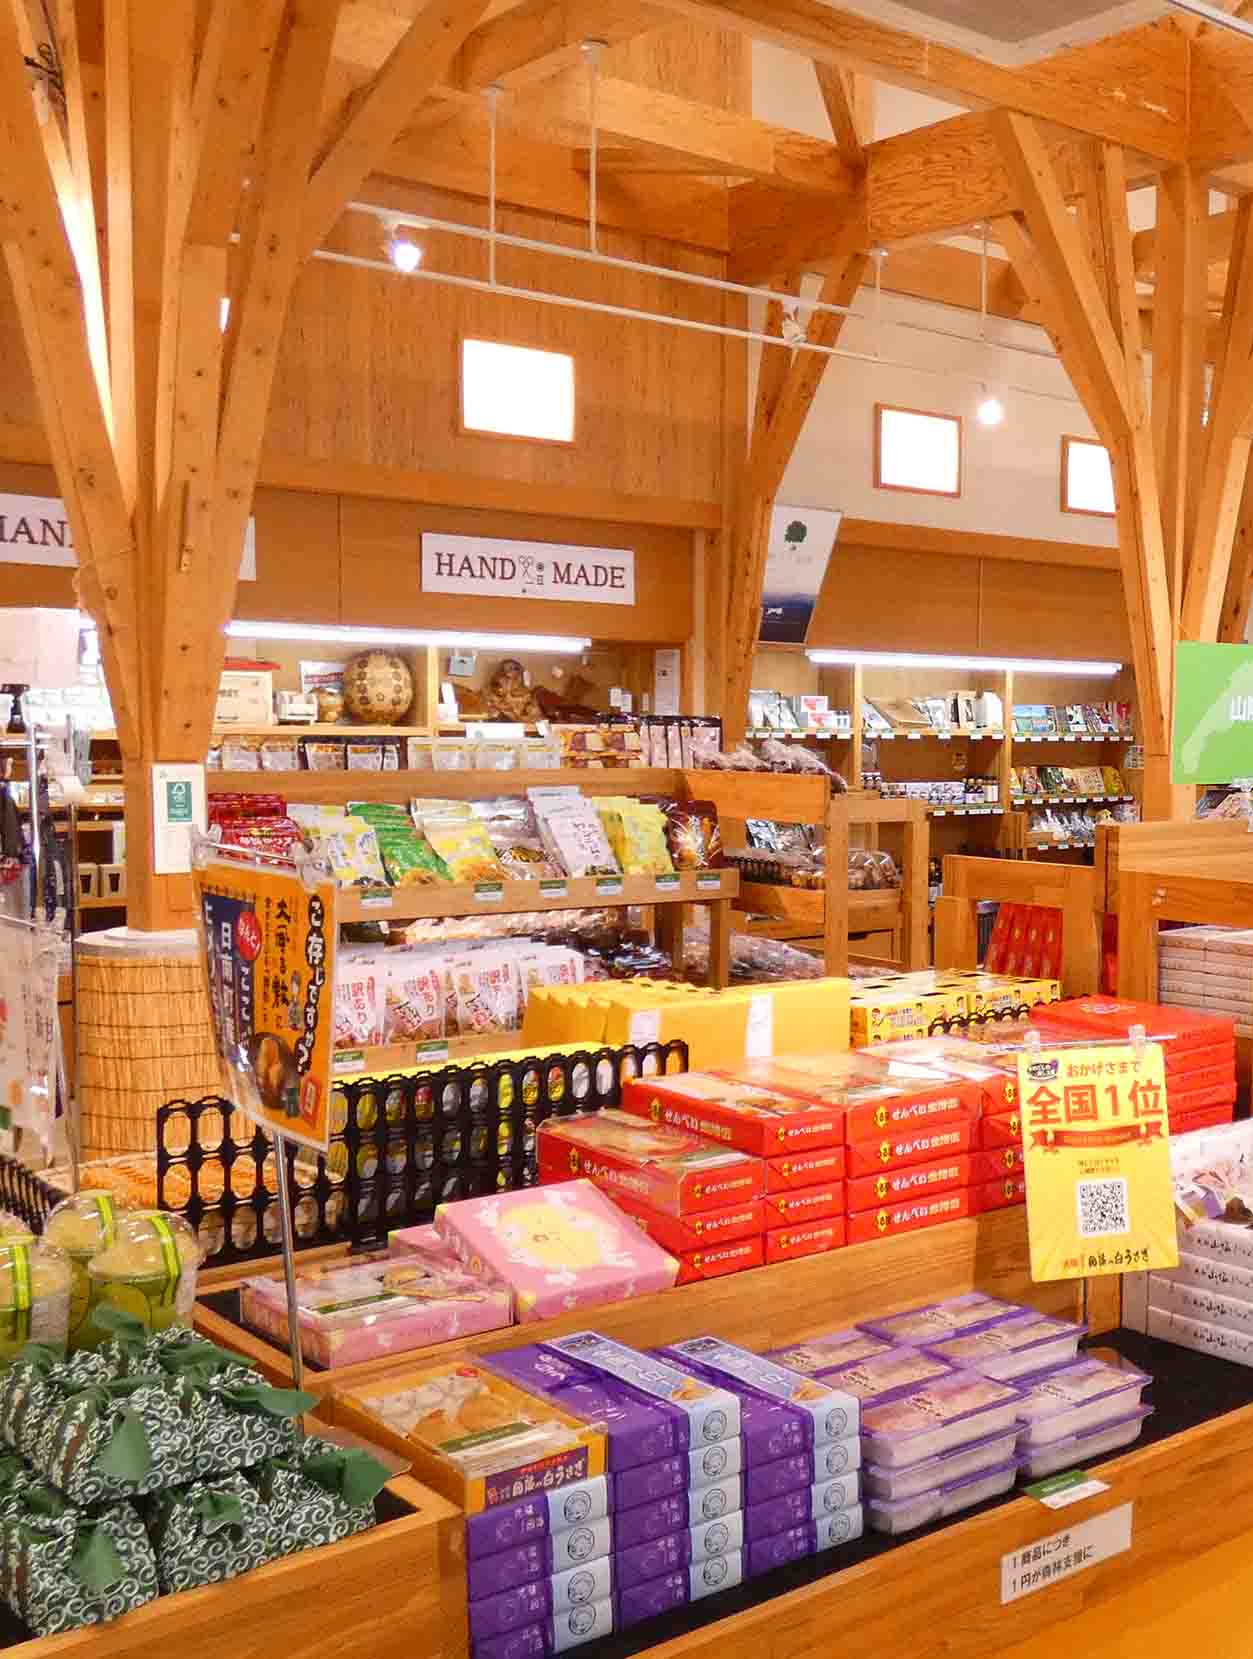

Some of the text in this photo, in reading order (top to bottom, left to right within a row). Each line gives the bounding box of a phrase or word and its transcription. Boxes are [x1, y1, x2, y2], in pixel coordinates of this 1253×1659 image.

[434, 552, 625, 588] HAND MADE
[1066, 1060, 1142, 1078] おかげさまで
[1027, 1080, 1164, 1126] 全国1位
